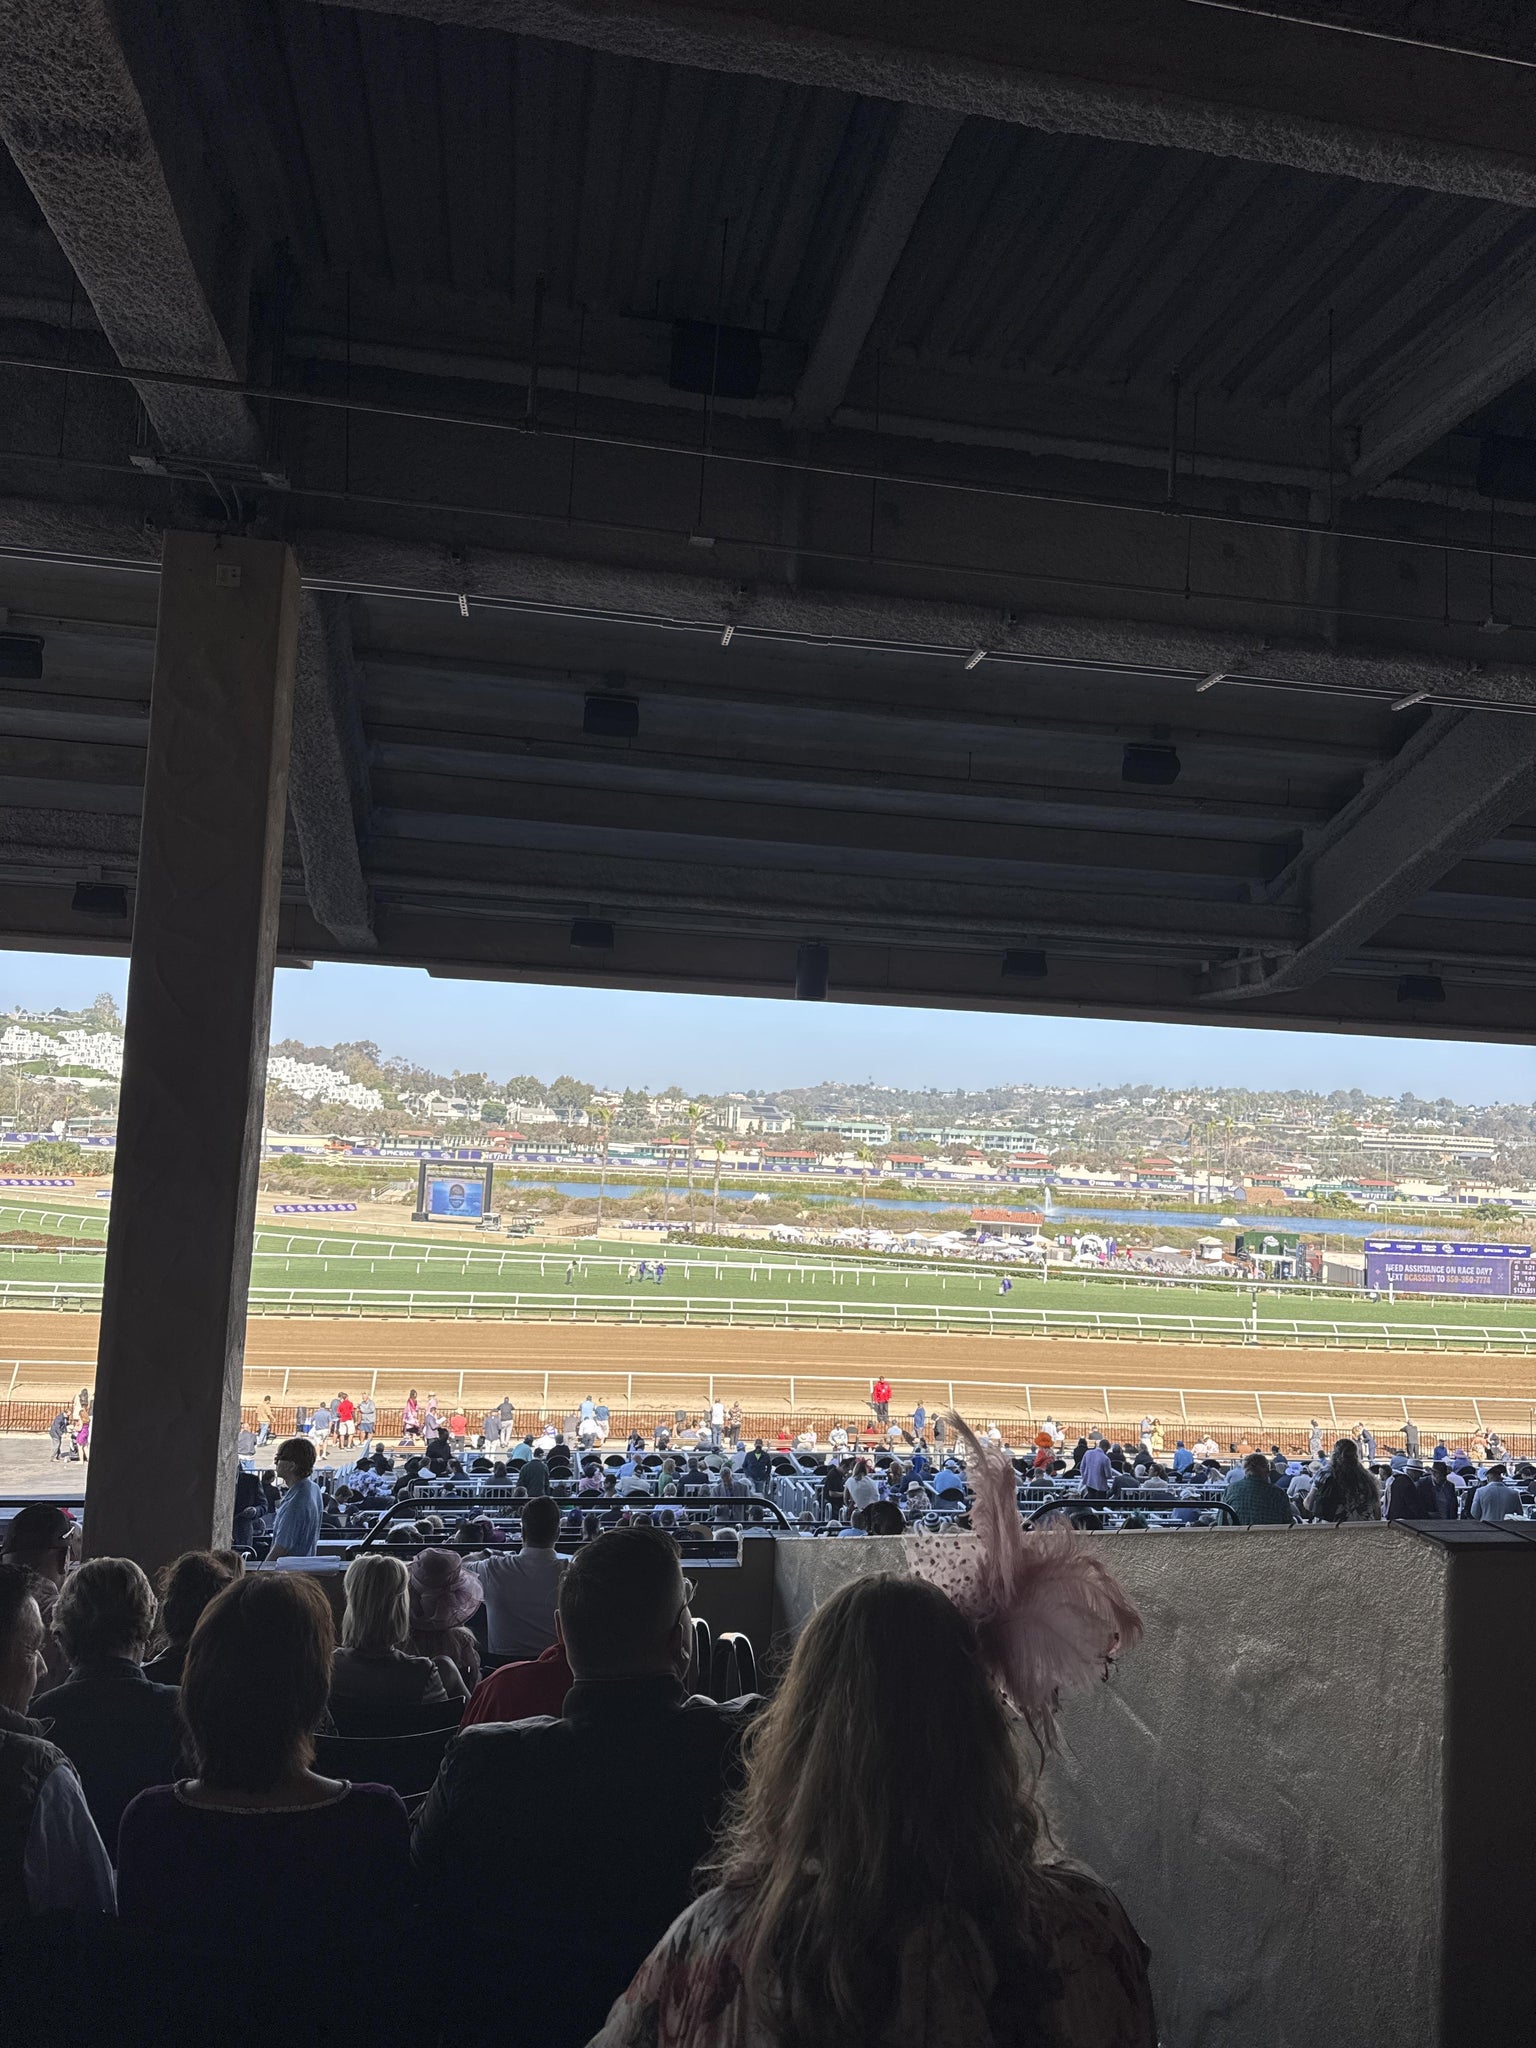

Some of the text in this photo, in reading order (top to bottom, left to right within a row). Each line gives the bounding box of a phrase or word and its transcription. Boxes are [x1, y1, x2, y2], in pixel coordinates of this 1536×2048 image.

[1385, 1264, 1493, 1276] NEED ASSISTANCE ON RACE DAY?
[1436, 1275, 1445, 1283] TO
